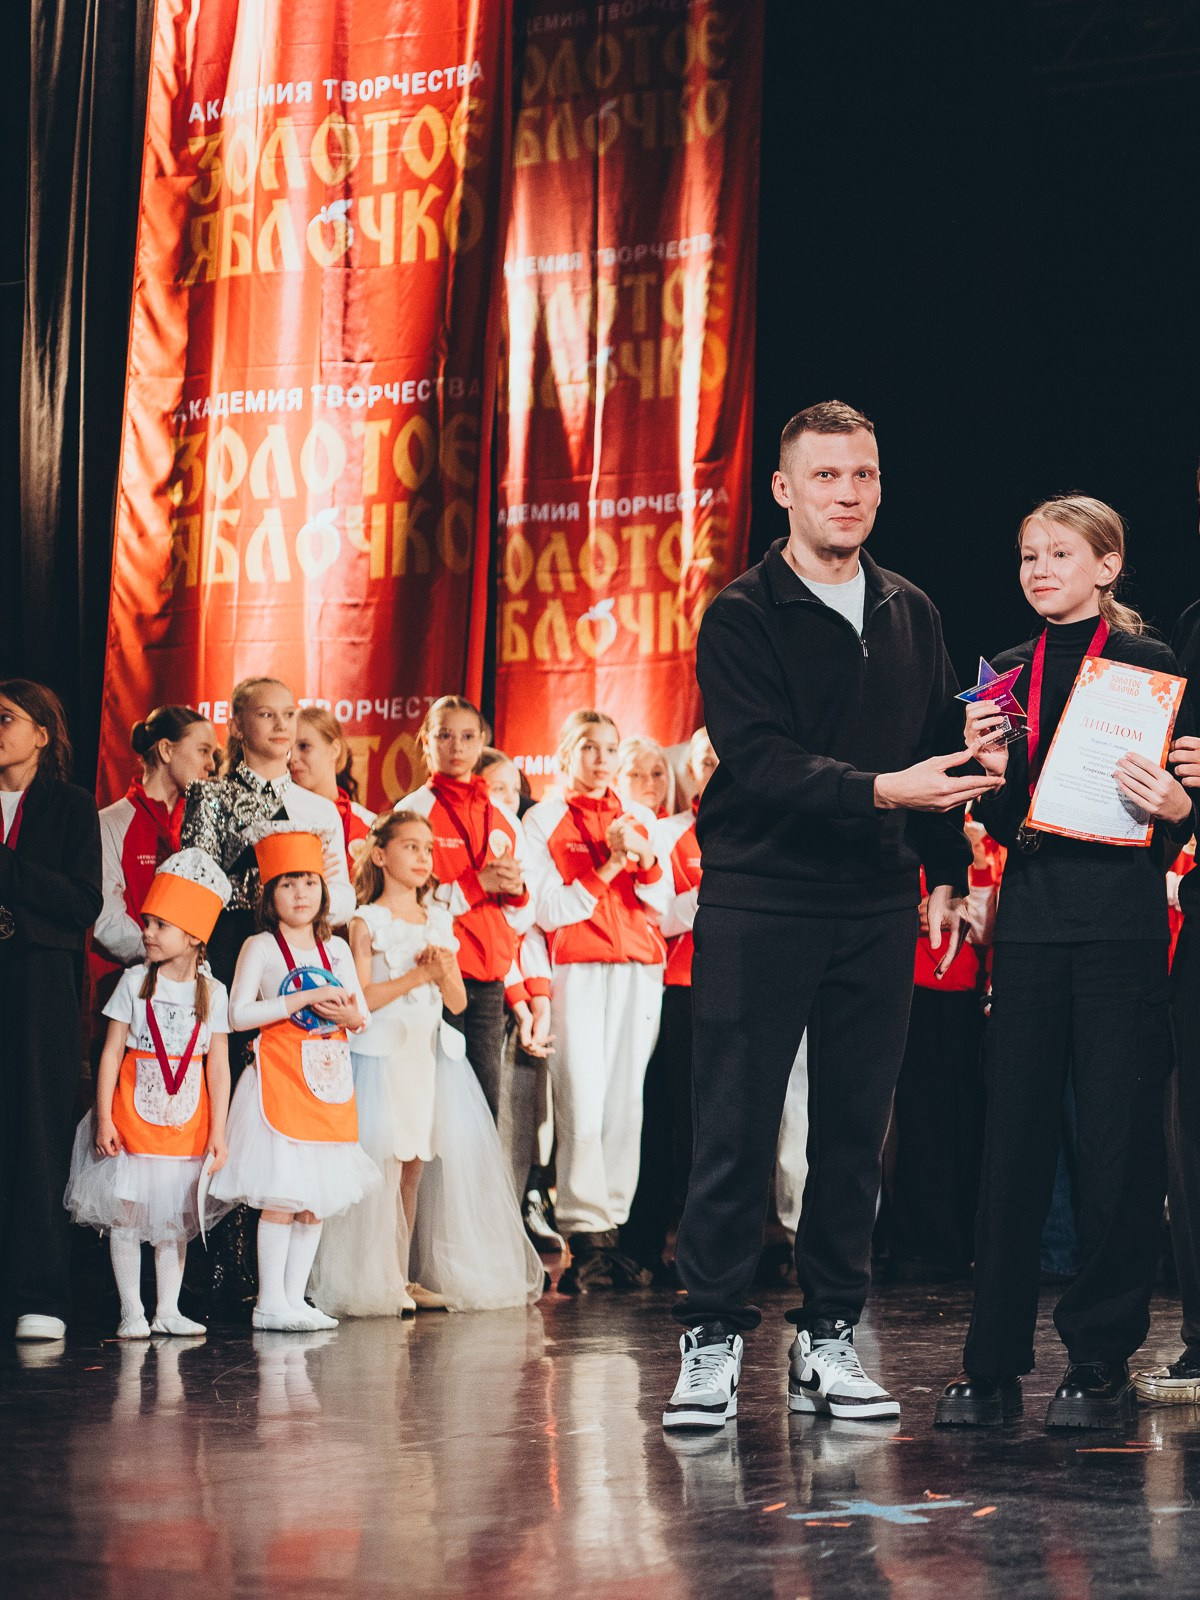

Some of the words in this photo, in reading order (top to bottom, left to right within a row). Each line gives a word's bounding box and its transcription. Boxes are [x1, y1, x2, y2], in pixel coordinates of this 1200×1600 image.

[188, 80, 313, 123] АКАДЕМИЯ
[322, 60, 484, 103] ТВОРЧЕСТВА
[514, 79, 732, 168] БЛОЧКО
[187, 97, 485, 205] ЗОЛОТОЕ
[182, 183, 485, 287] ЯБЛОЧКО
[171, 386, 304, 425] АКАДЕМИЯ
[310, 375, 482, 411] ТВОРЧЕСТВА
[169, 413, 480, 508] ЗОЛОТОЕ
[160, 498, 478, 590] ЯБЛОЧКО
[497, 501, 580, 527] АДЕМИЯ
[504, 516, 731, 595] ОЛОТОЕ
[1079, 715, 1143, 742] ДИПЛОМ
